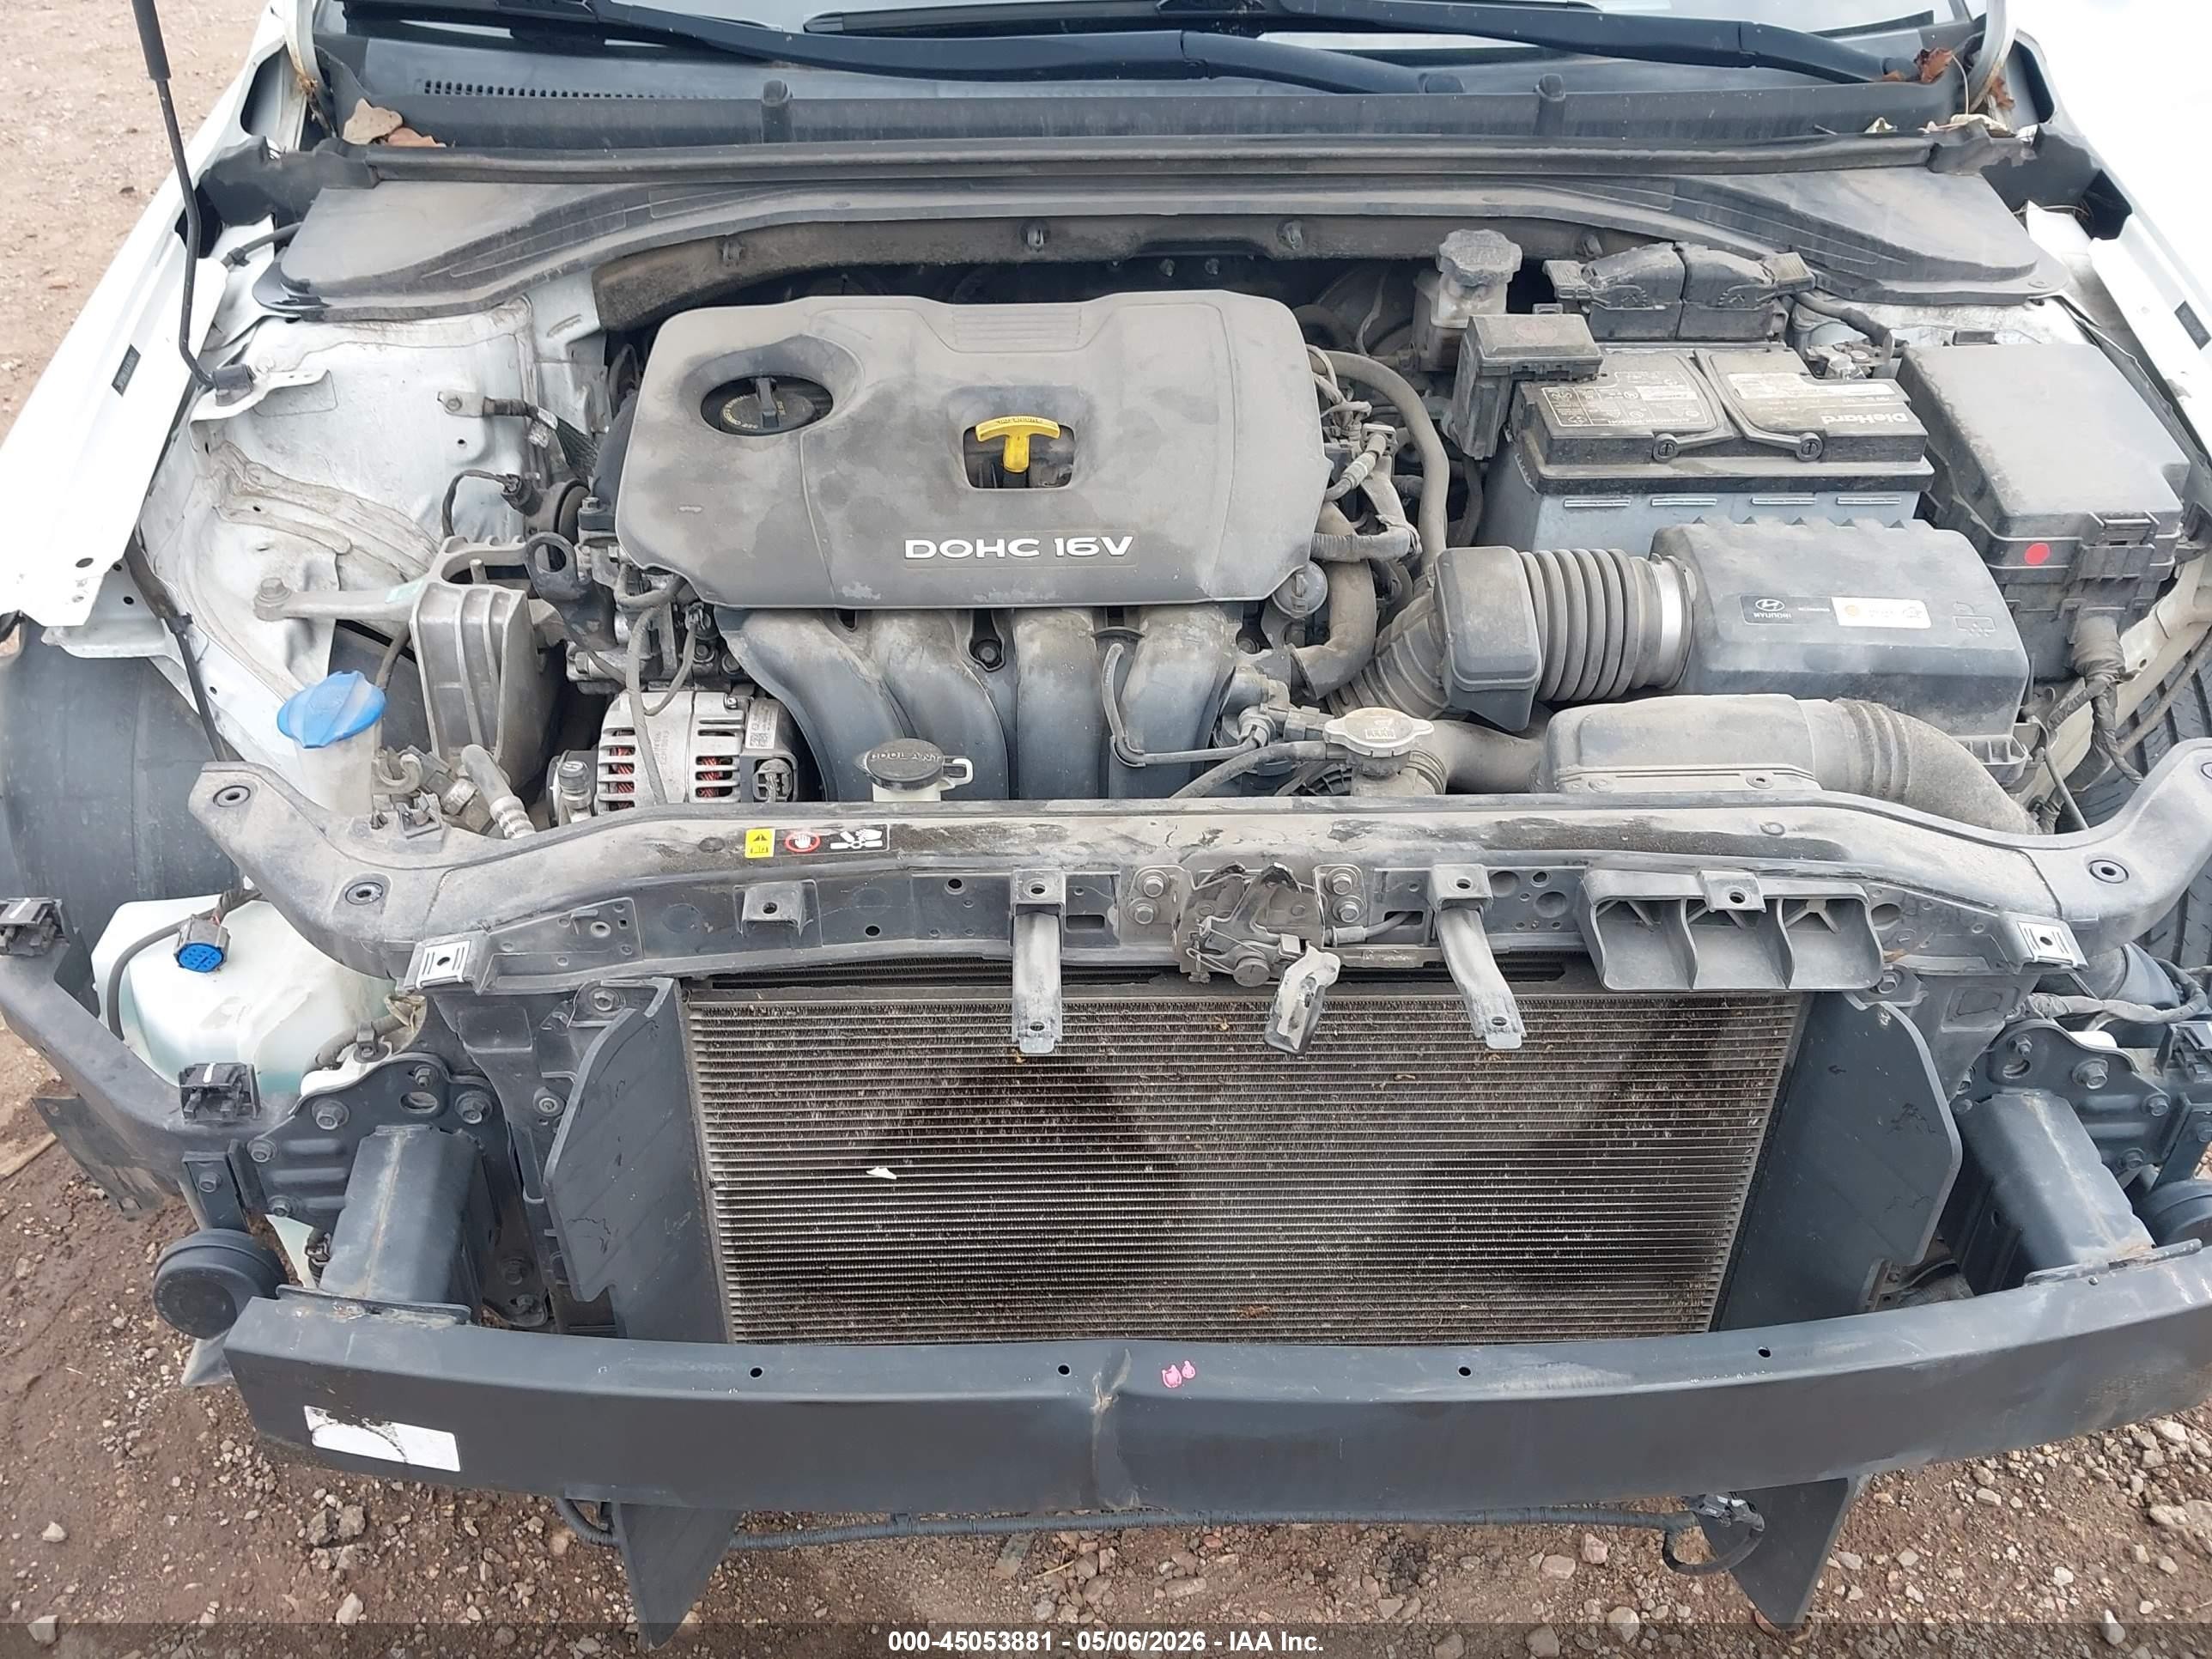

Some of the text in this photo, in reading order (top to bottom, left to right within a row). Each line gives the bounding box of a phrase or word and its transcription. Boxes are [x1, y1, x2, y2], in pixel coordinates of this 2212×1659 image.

[904, 536, 1133, 559] DOHC 16V
[871, 752, 941, 763] COOLANT
